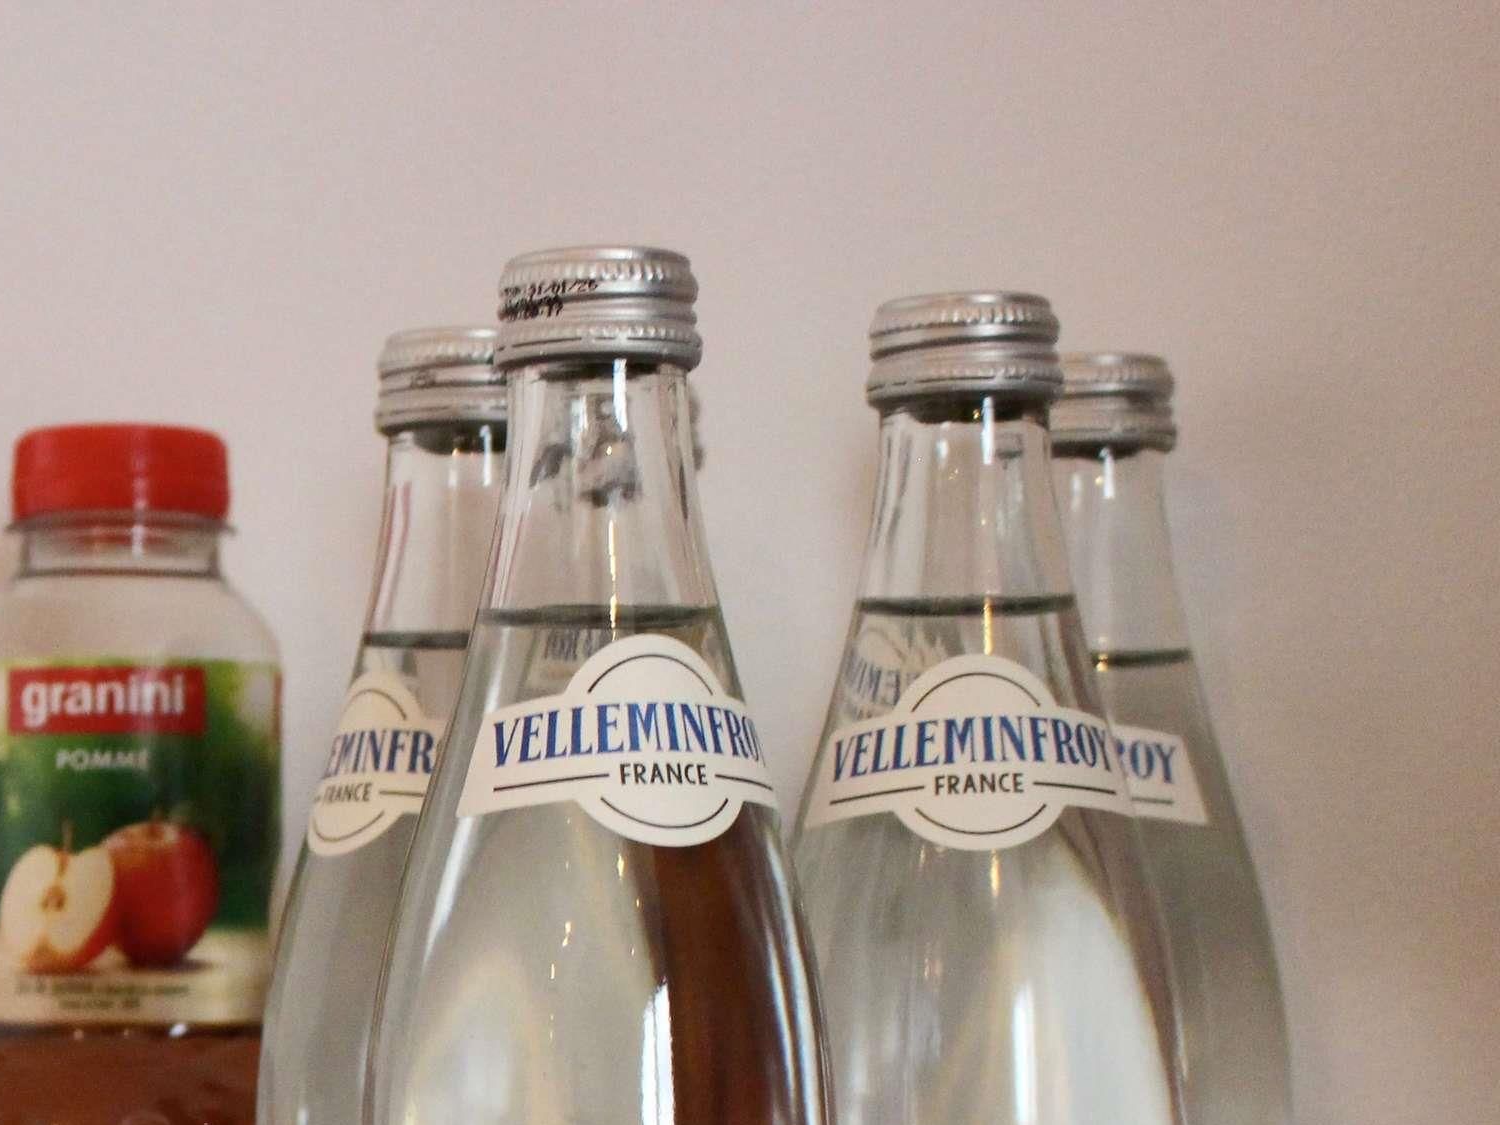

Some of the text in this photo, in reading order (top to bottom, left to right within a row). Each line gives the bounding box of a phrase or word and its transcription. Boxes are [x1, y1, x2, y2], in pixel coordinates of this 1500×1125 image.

[20, 674, 186, 728] granini
[493, 702, 766, 767] VELLEMINFRO
[833, 715, 1112, 783] VELLEMINFROY
[619, 763, 709, 786] FRANCE
[934, 772, 1025, 796] FRANCE
